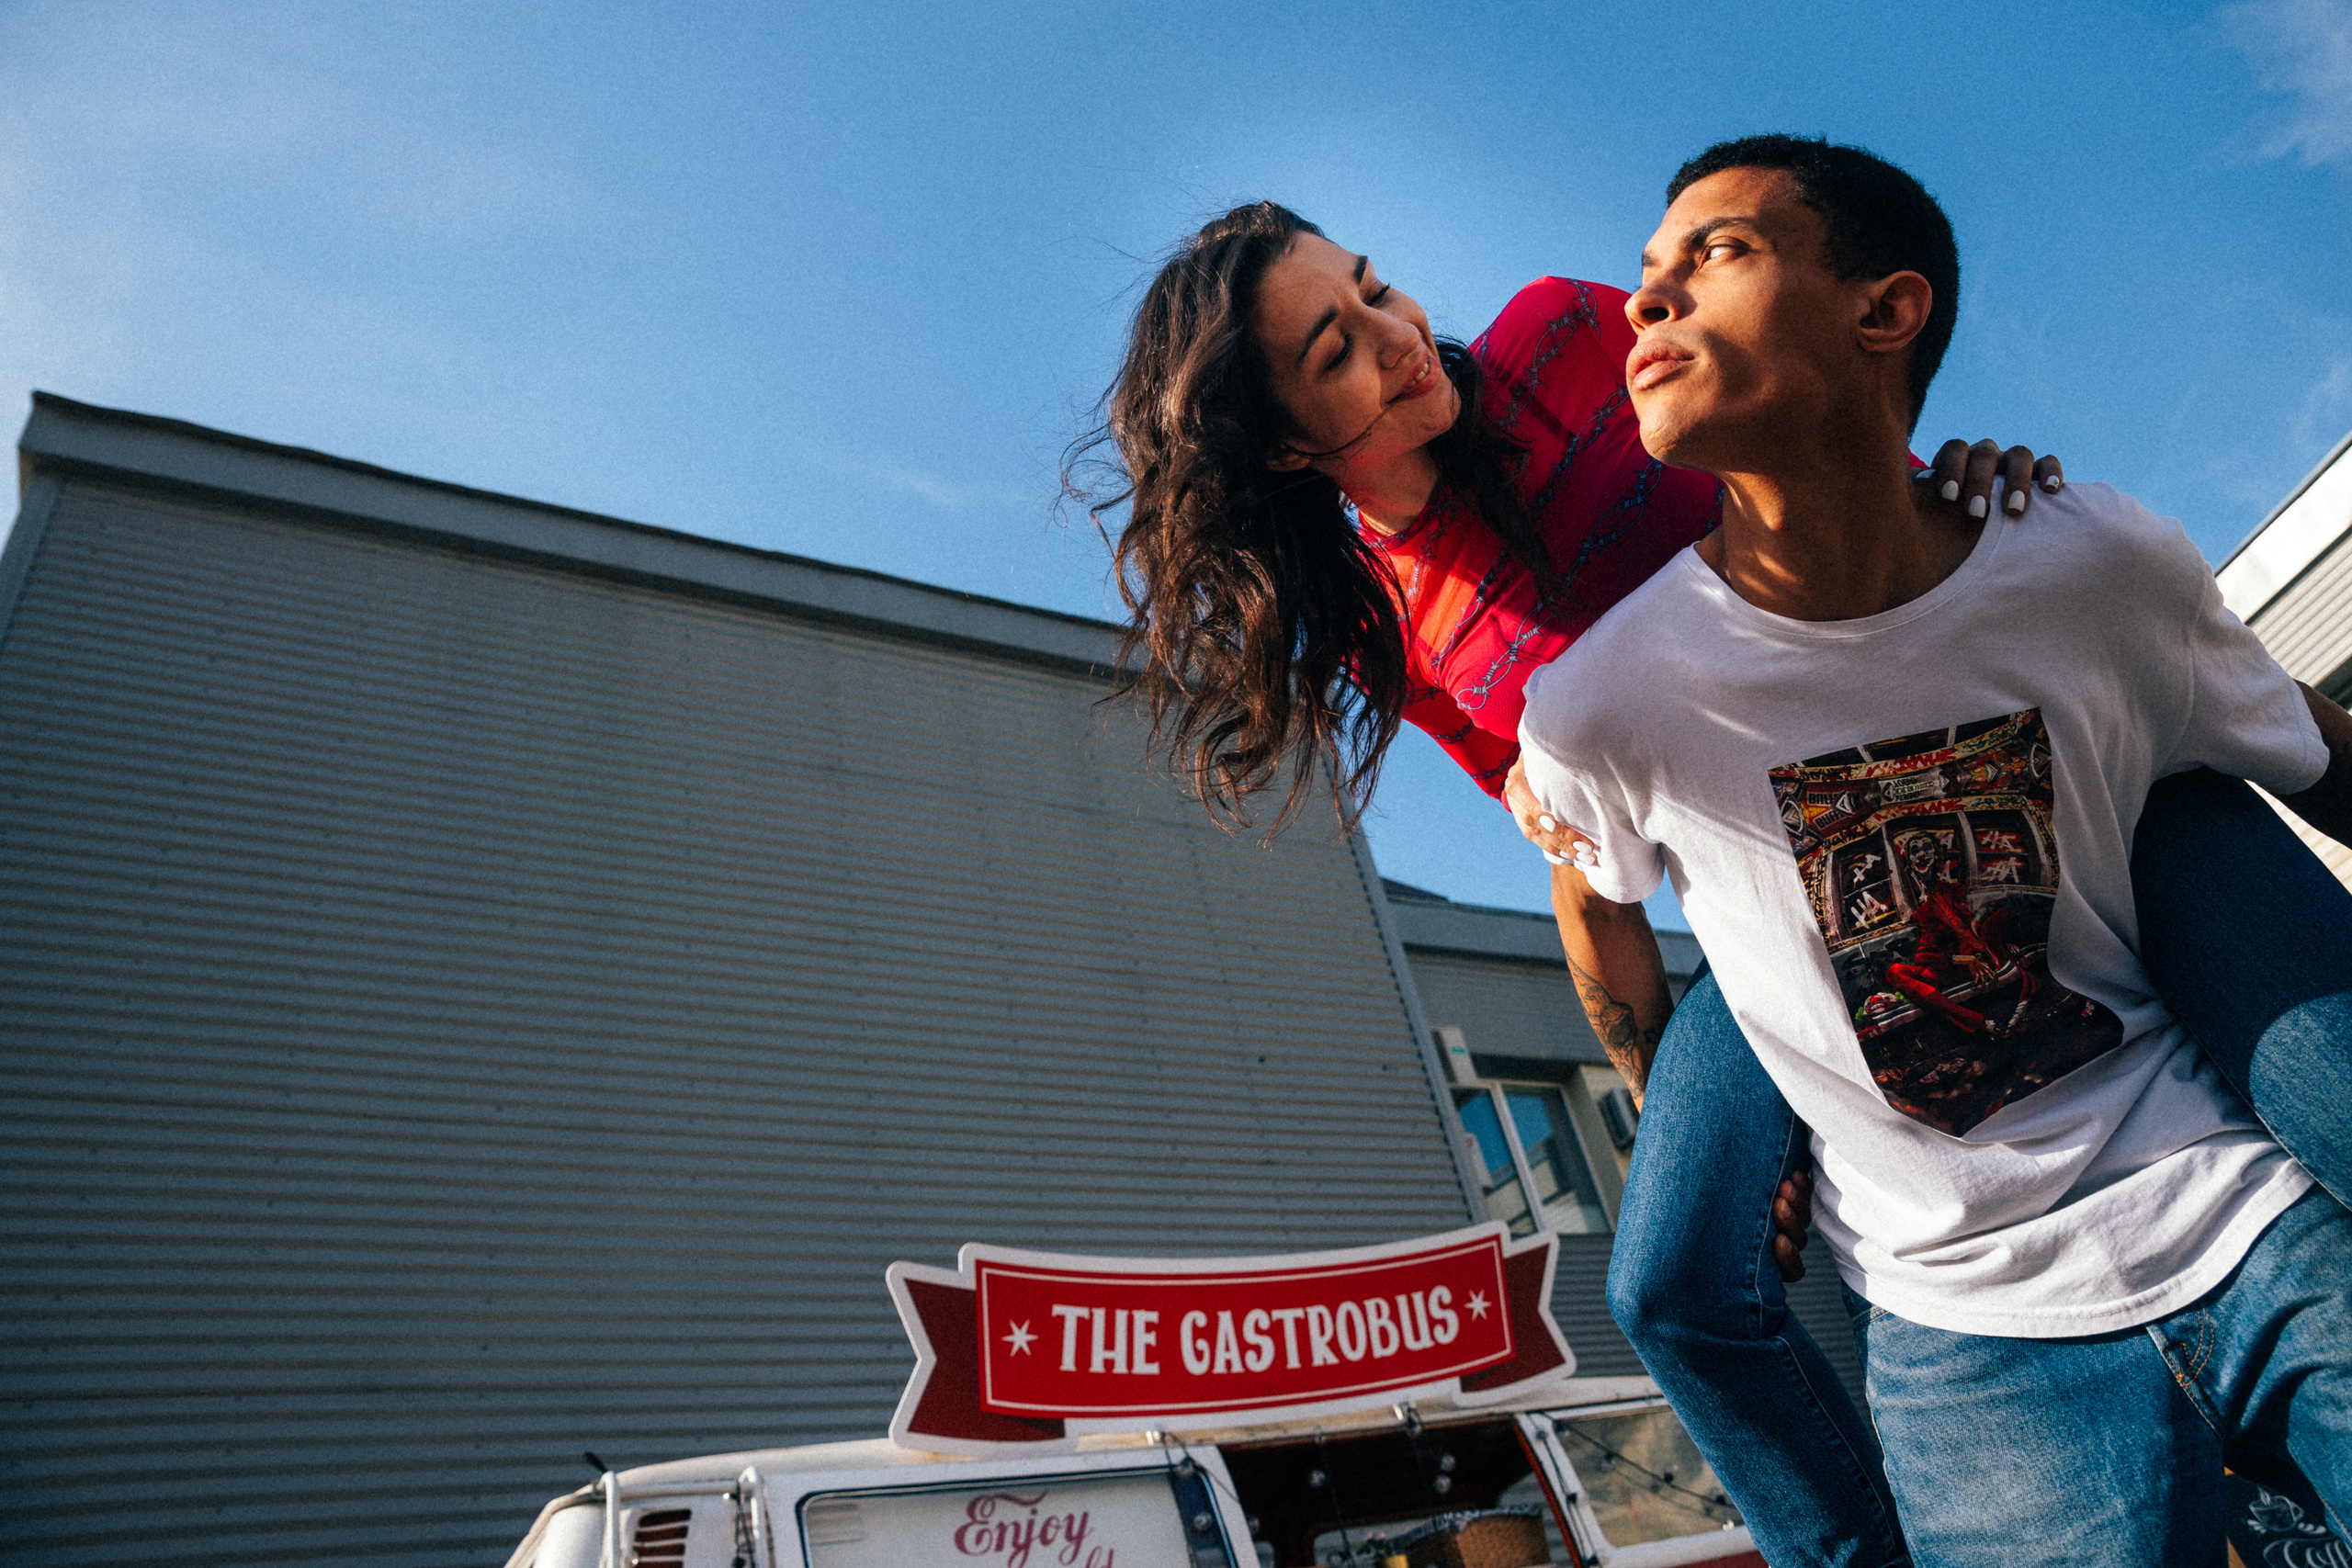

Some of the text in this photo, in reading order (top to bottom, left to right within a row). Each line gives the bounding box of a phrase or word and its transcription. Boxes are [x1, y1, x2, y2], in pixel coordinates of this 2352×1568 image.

[1051, 1285, 1460, 1375] THE GASTROBUS
[954, 1489, 1094, 1568] Enjoy
